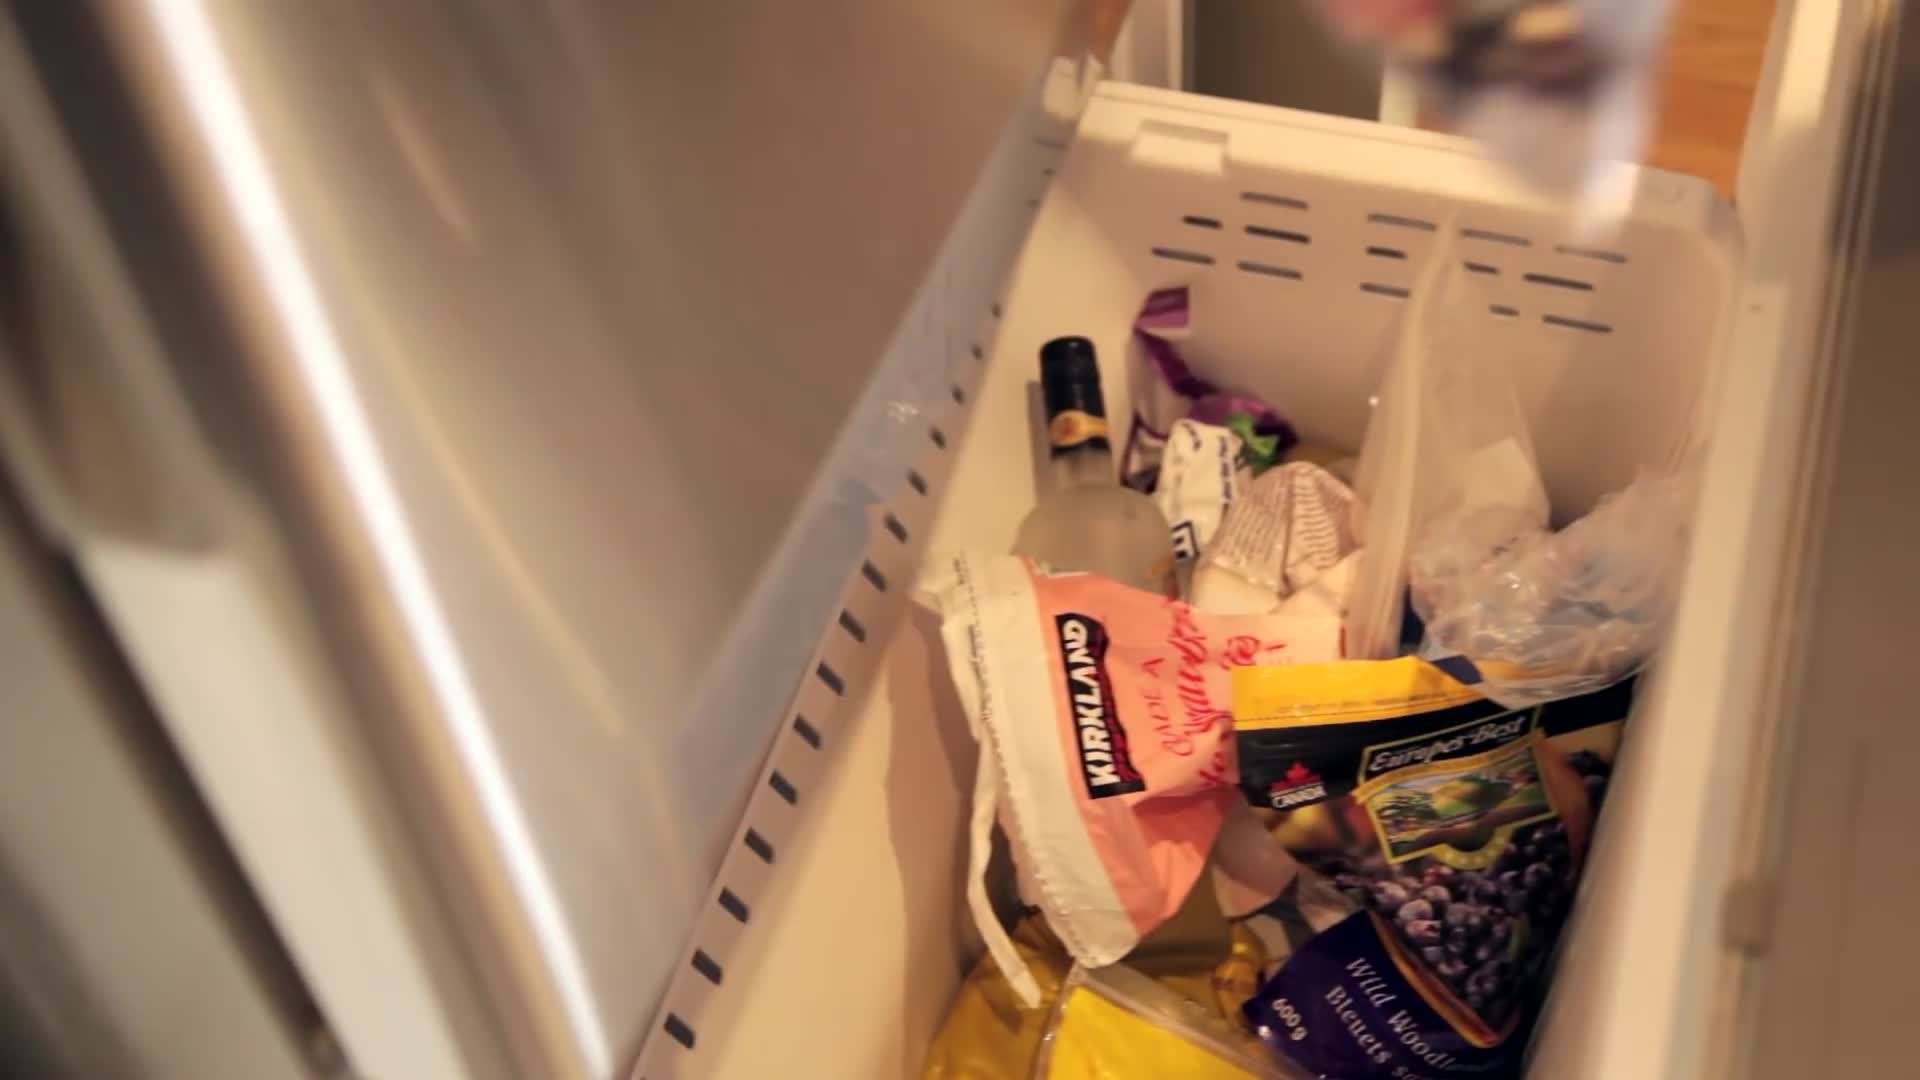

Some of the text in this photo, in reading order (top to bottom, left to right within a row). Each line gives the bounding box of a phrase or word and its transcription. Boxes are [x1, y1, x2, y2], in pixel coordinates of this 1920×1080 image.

[1062, 619, 1121, 787] KIRKLAND
[1346, 957, 1396, 1008] Wild
[1325, 986, 1392, 1064] Bleuets
